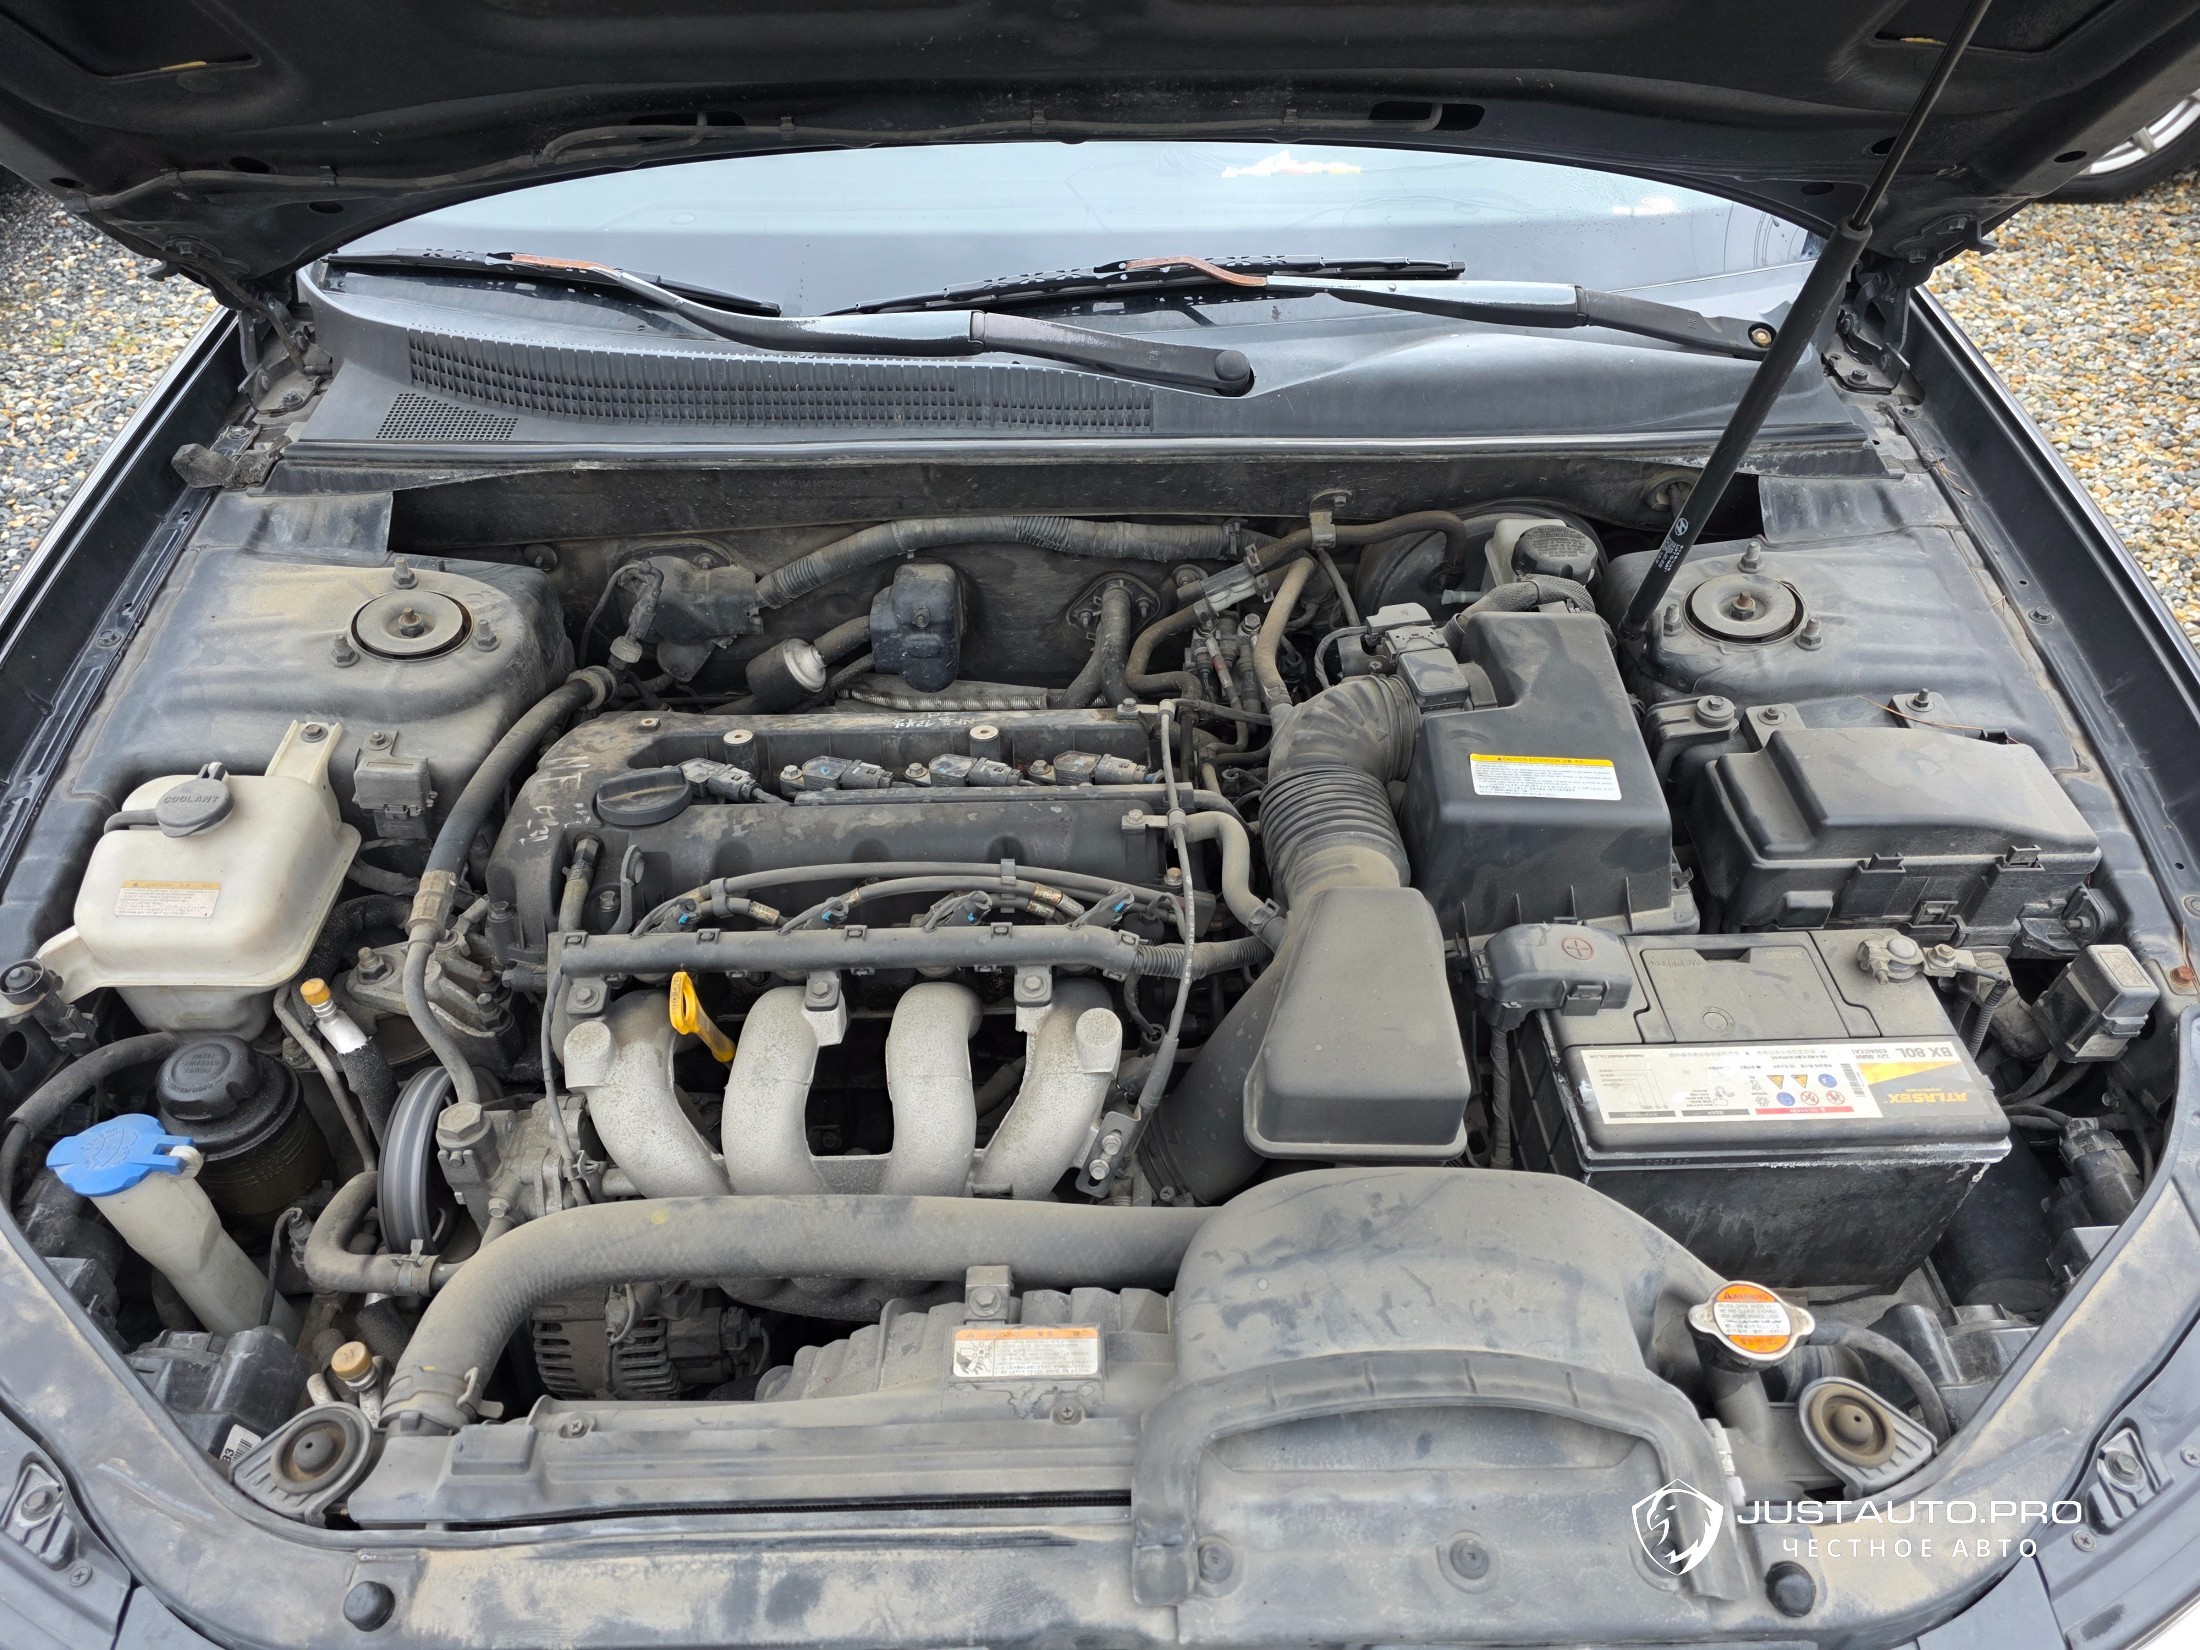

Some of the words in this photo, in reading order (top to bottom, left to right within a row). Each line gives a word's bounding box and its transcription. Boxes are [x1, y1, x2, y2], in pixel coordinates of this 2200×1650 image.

[163, 795, 220, 804] COOLANT
[1895, 1047, 1927, 1058] 80L
[1929, 1047, 1954, 1058] BX
[1887, 1092, 1968, 1104] ATLASBX
[1733, 1292, 1769, 1300] WARNING
